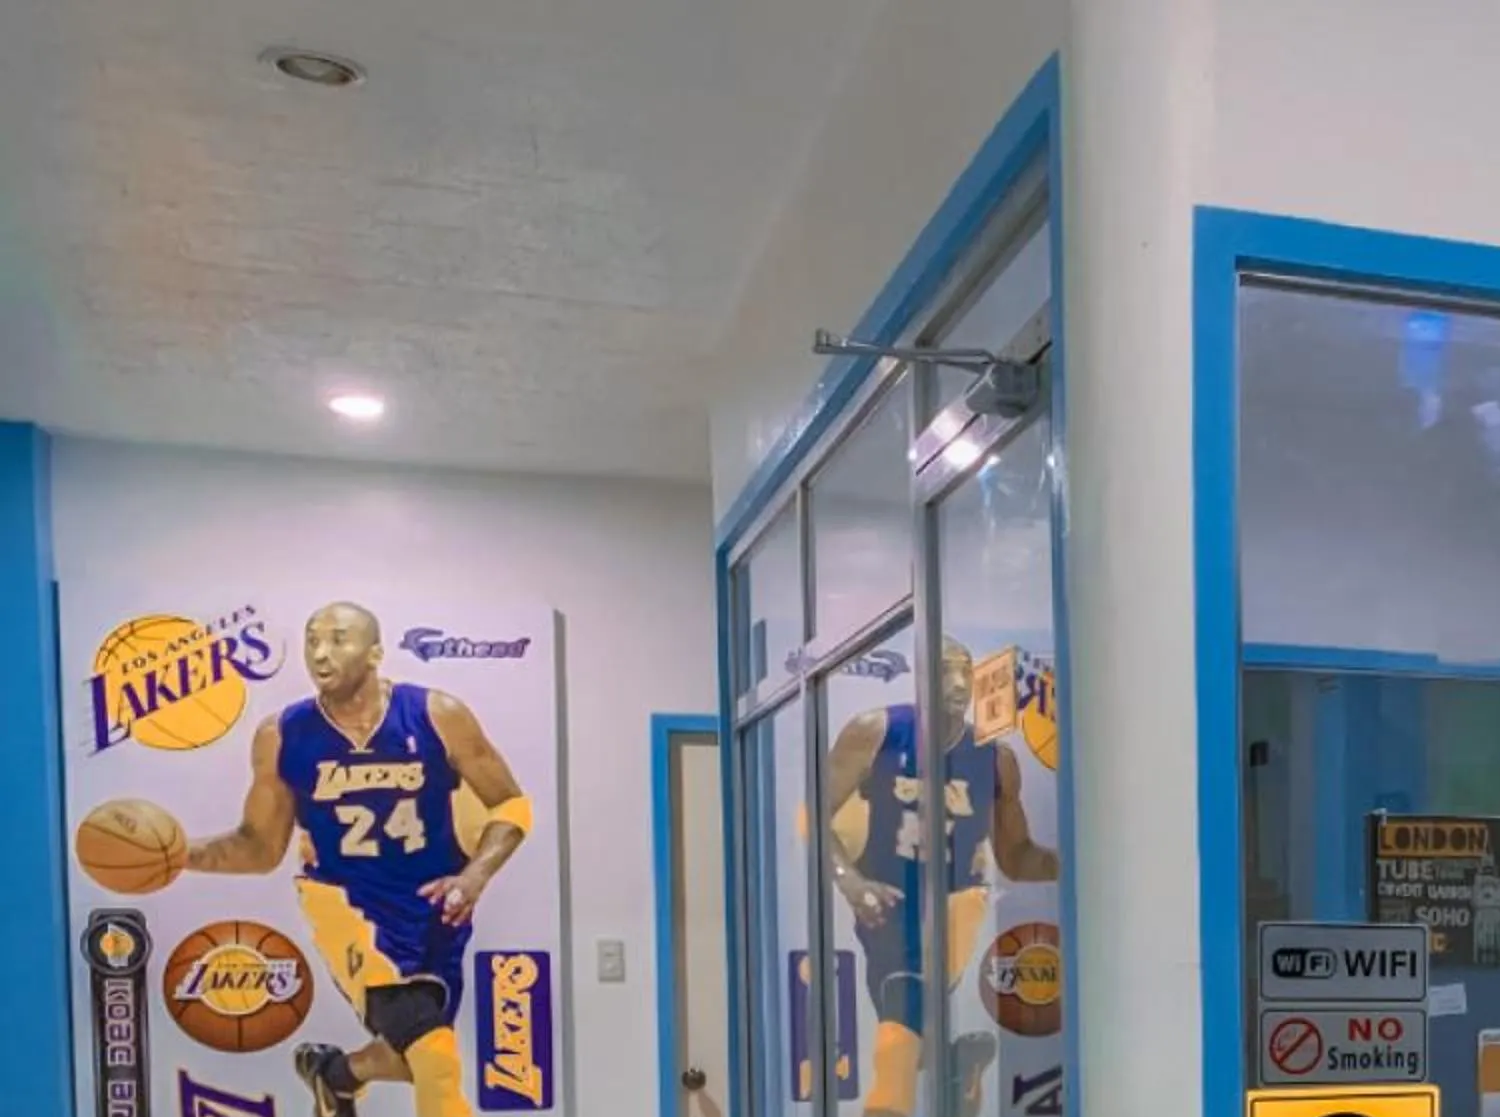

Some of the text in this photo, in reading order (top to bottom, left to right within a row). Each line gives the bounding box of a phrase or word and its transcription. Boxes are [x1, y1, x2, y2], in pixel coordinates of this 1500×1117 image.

[88, 621, 286, 757] LAKERS
[334, 798, 427, 856] 24
[1381, 826, 1485, 850] LONDON
[1415, 905, 1470, 928] SOHO
[1344, 949, 1417, 978] WIFI
[181, 962, 293, 998] LAKERS
[104, 978, 137, 1066] KOBE
[1348, 1017, 1403, 1041] NO
[1327, 1046, 1419, 1075] Smoking
